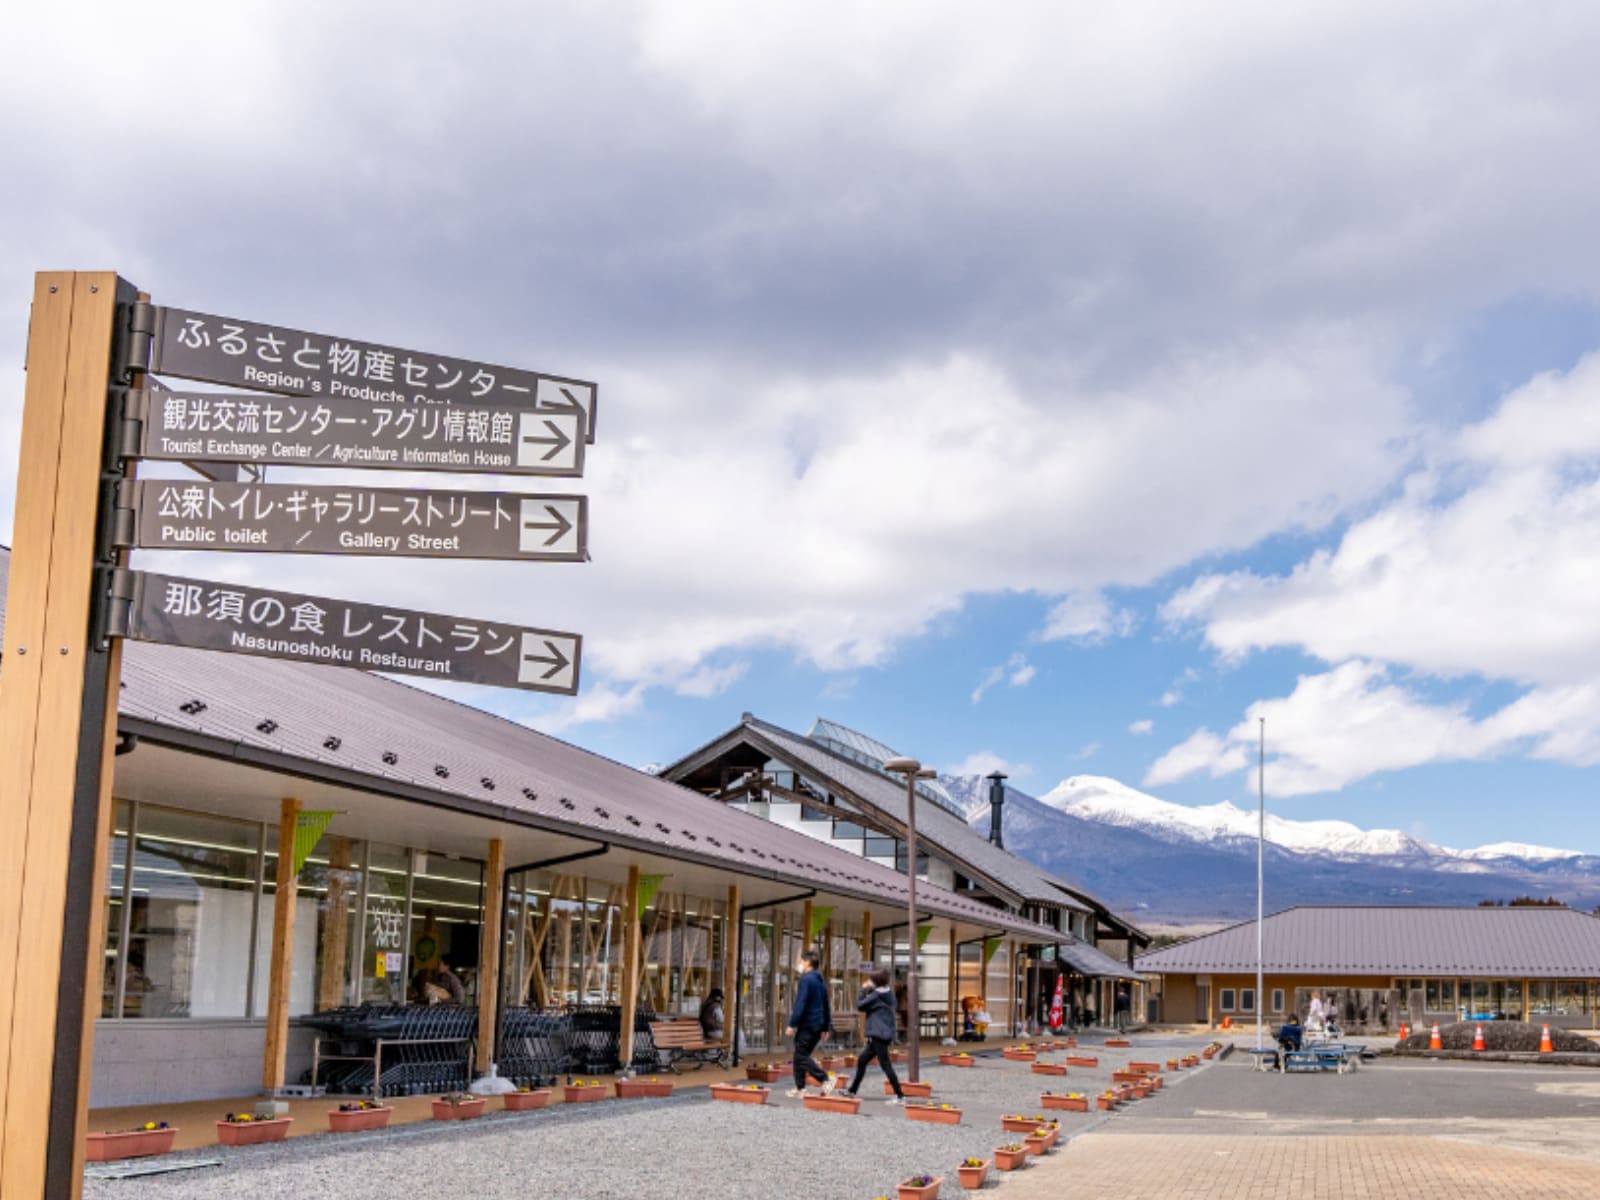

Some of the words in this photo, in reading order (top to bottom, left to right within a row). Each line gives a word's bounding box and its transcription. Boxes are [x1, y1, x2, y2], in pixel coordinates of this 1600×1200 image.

[177, 317, 531, 397] ふるさと物産センター
[243, 364, 322, 393] Region's
[161, 437, 203, 454] Tourist
[207, 439, 267, 459] Exchange
[271, 441, 313, 458] Center
[332, 444, 399, 463] Agriculture
[403, 448, 470, 464] Information
[474, 449, 512, 466] House
[161, 525, 217, 543] Public
[224, 527, 269, 544] toilet
[338, 530, 401, 551] Gallery
[407, 533, 460, 550] Street
[163, 582, 328, 636] 那須の食
[343, 608, 515, 656] レストラン
[231, 630, 353, 661] Nasunoshoku
[359, 647, 452, 674] Restaurant
